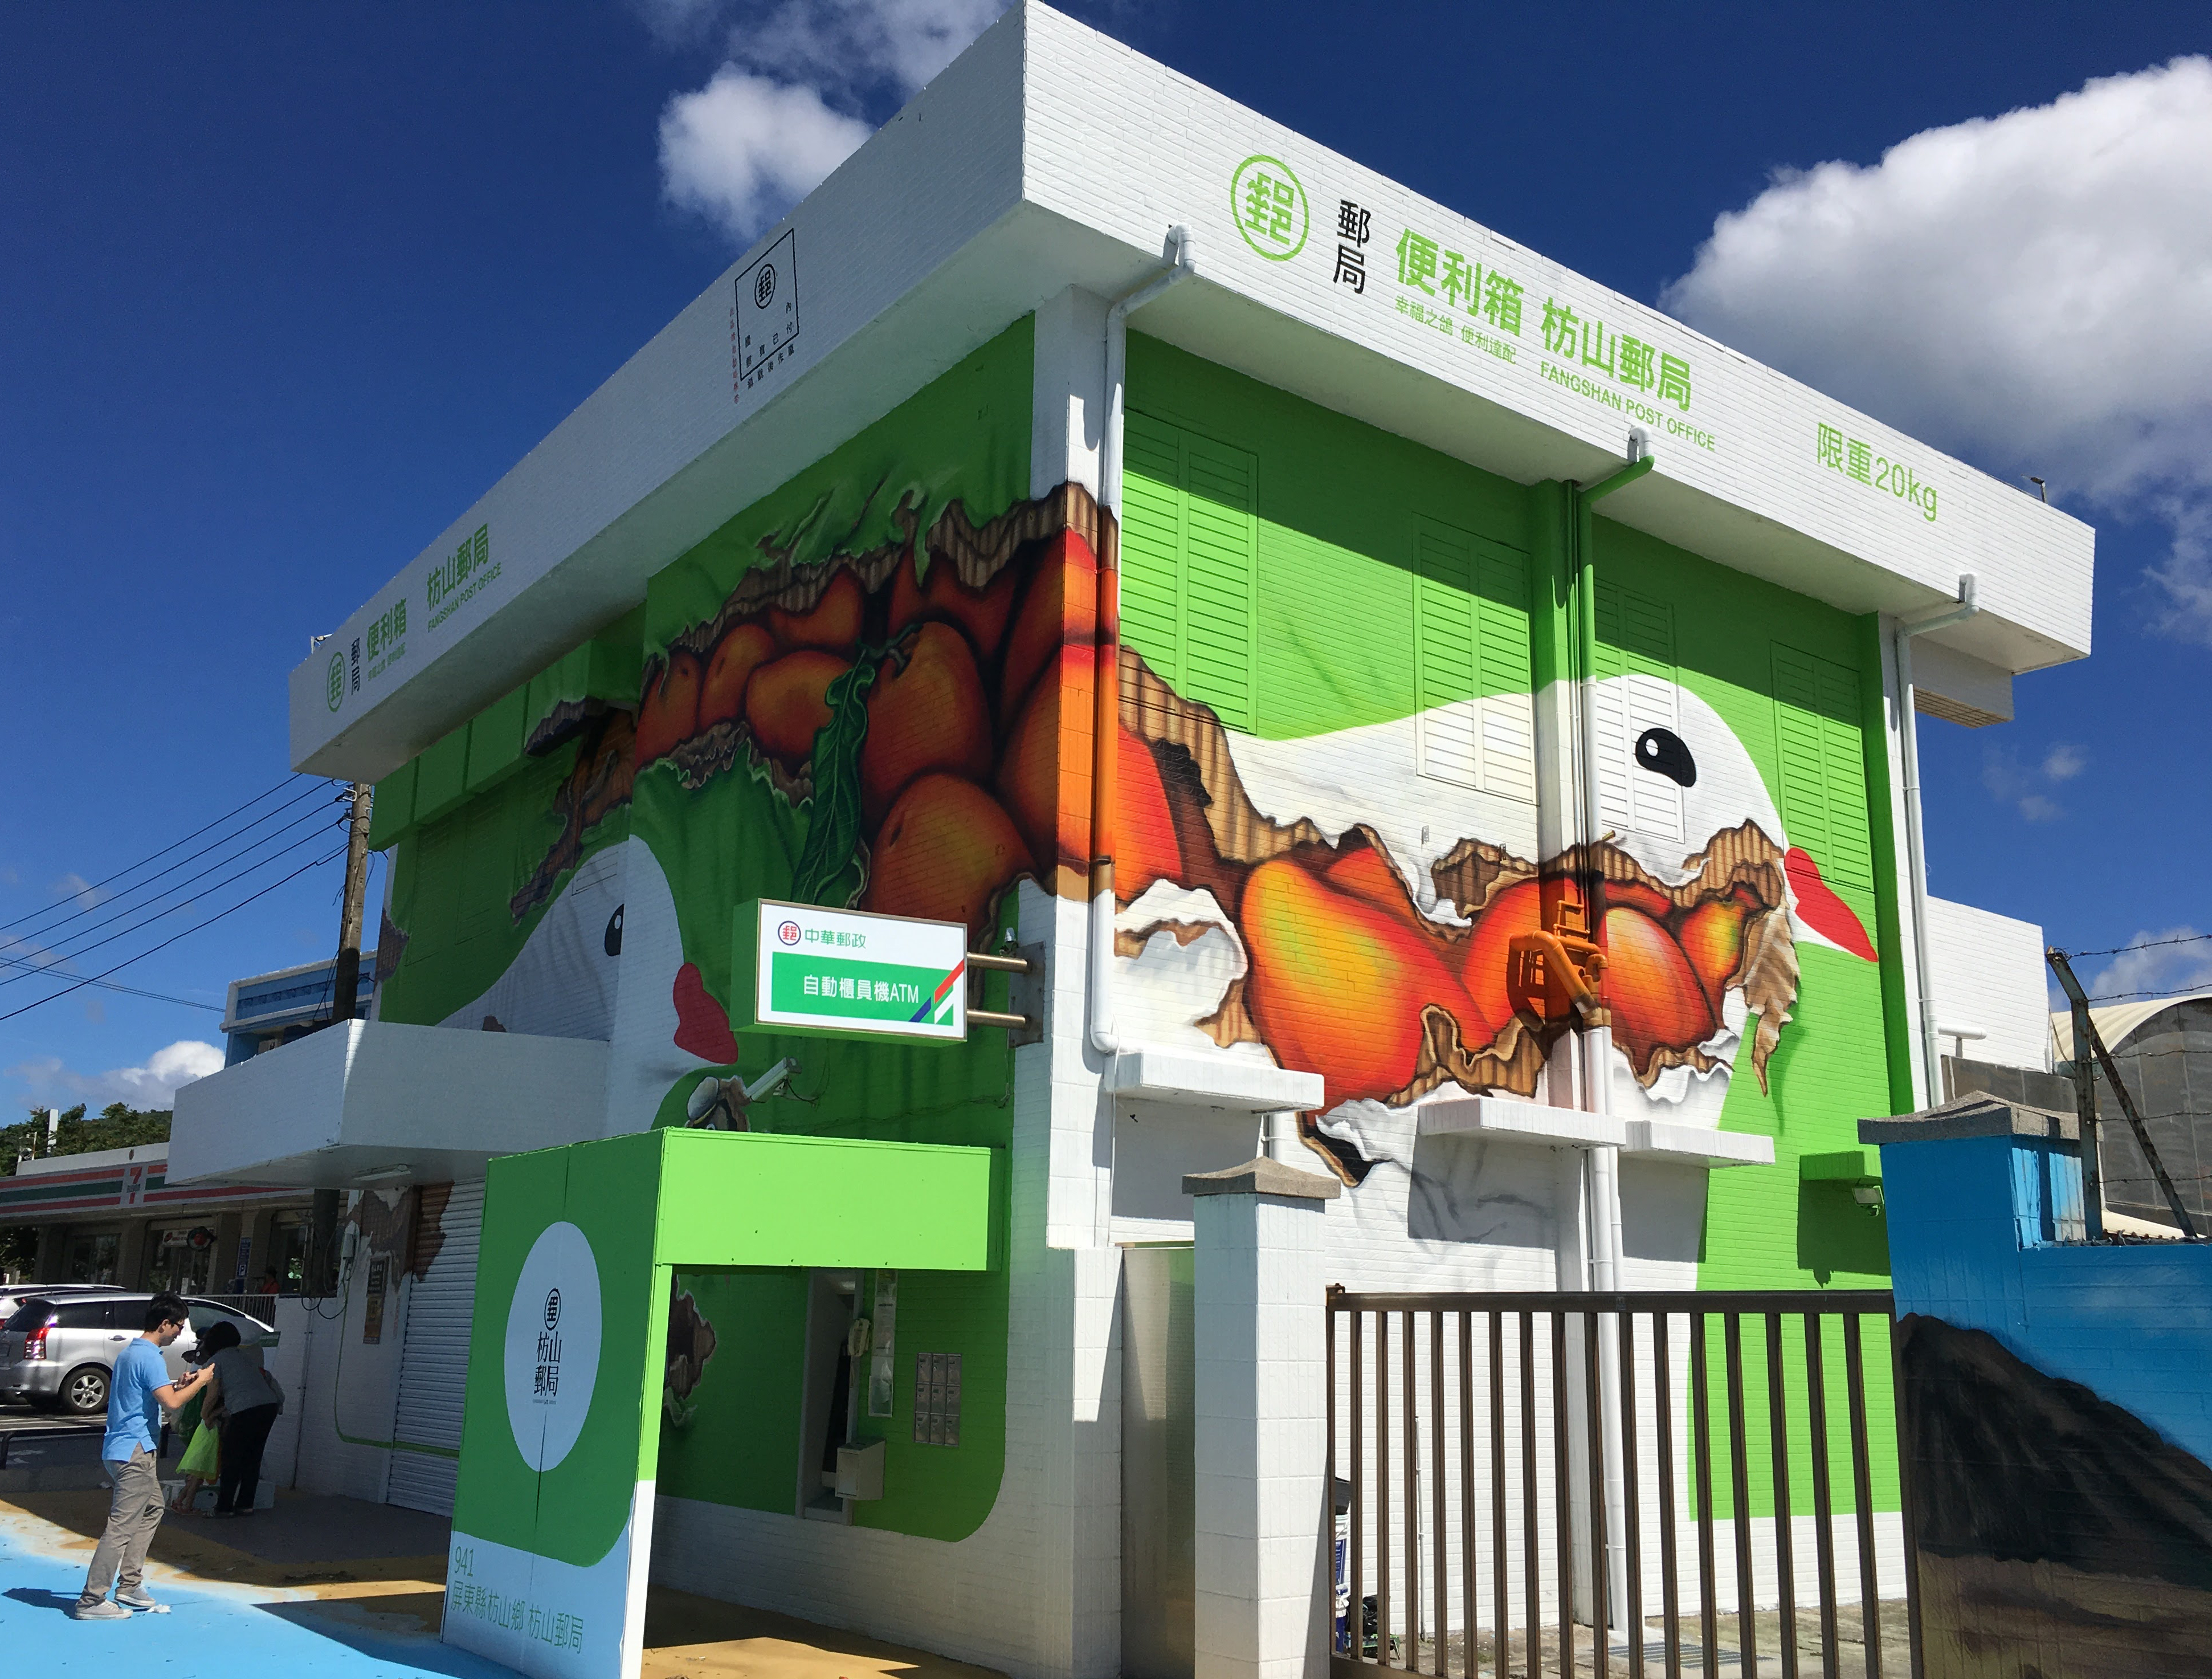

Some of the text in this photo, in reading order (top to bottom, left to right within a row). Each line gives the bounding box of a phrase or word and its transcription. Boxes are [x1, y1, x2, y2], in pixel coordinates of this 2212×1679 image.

[1333, 199, 1372, 294] 郵局
[1395, 227, 1691, 411] 便利箱 枋山郵局
[1395, 295, 1516, 365] 幸福之鴿 便利達配
[1540, 360, 1715, 452] FANGSHAN POST OFFICE
[1817, 422, 1938, 522] 限重20kg
[427, 523, 489, 612] 枋山郵局
[367, 598, 406, 662] 便利箱
[351, 637, 360, 695] 郵局
[805, 928, 867, 949] 中華郵政
[803, 975, 919, 1004] 自動櫃員機ATM
[534, 1364, 559, 1397] 郵局
[536, 1331, 562, 1363] 枋山
[454, 1546, 474, 1577] 941
[450, 1580, 583, 1654] 屏東縣枋山鄉 枋山郵局
